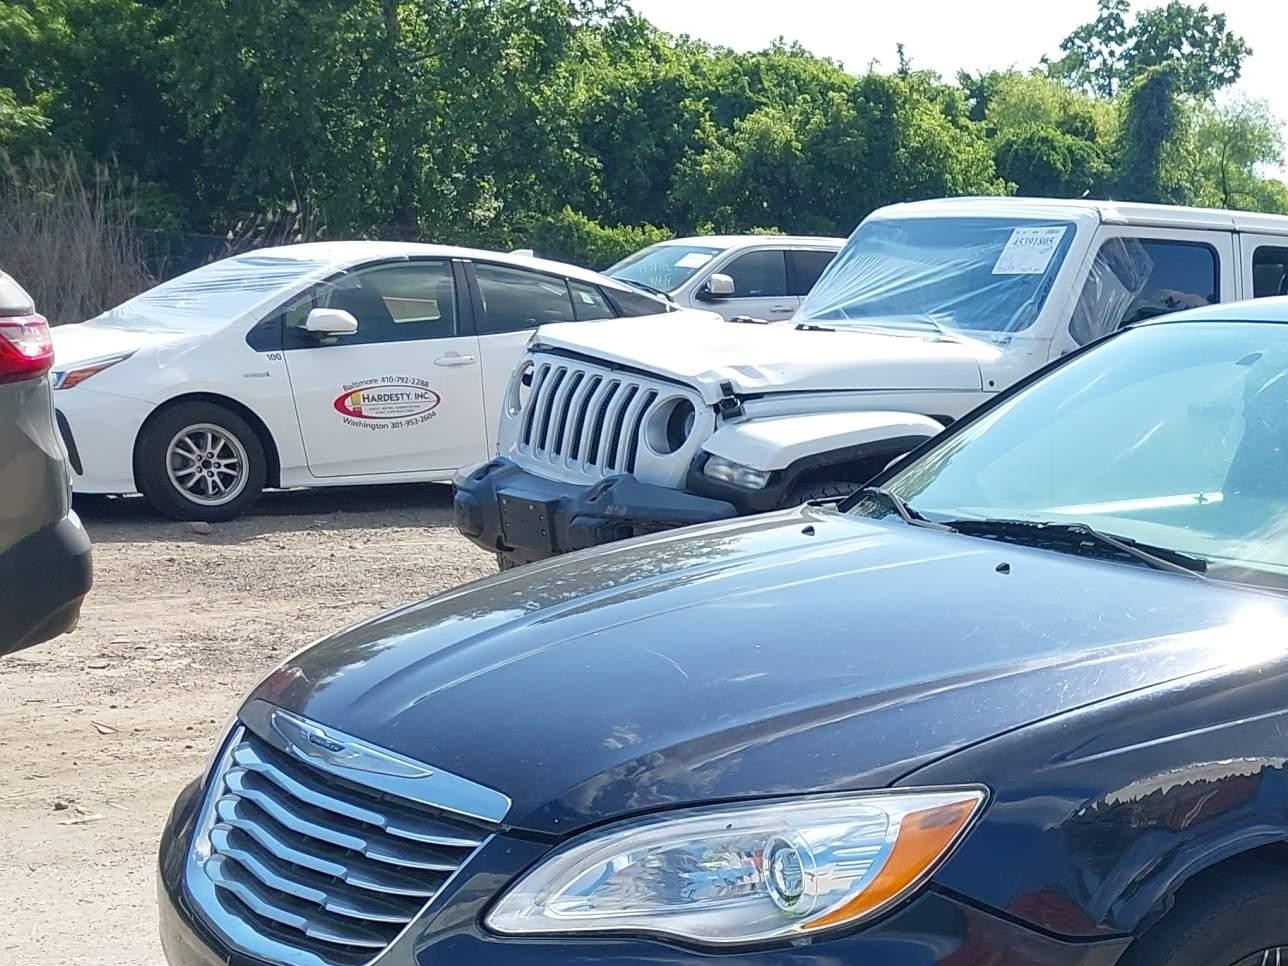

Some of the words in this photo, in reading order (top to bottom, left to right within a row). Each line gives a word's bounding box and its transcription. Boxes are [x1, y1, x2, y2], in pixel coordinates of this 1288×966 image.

[266, 353, 282, 361] 100
[342, 378, 378, 391] Baltimore
[342, 417, 389, 431] Washington
